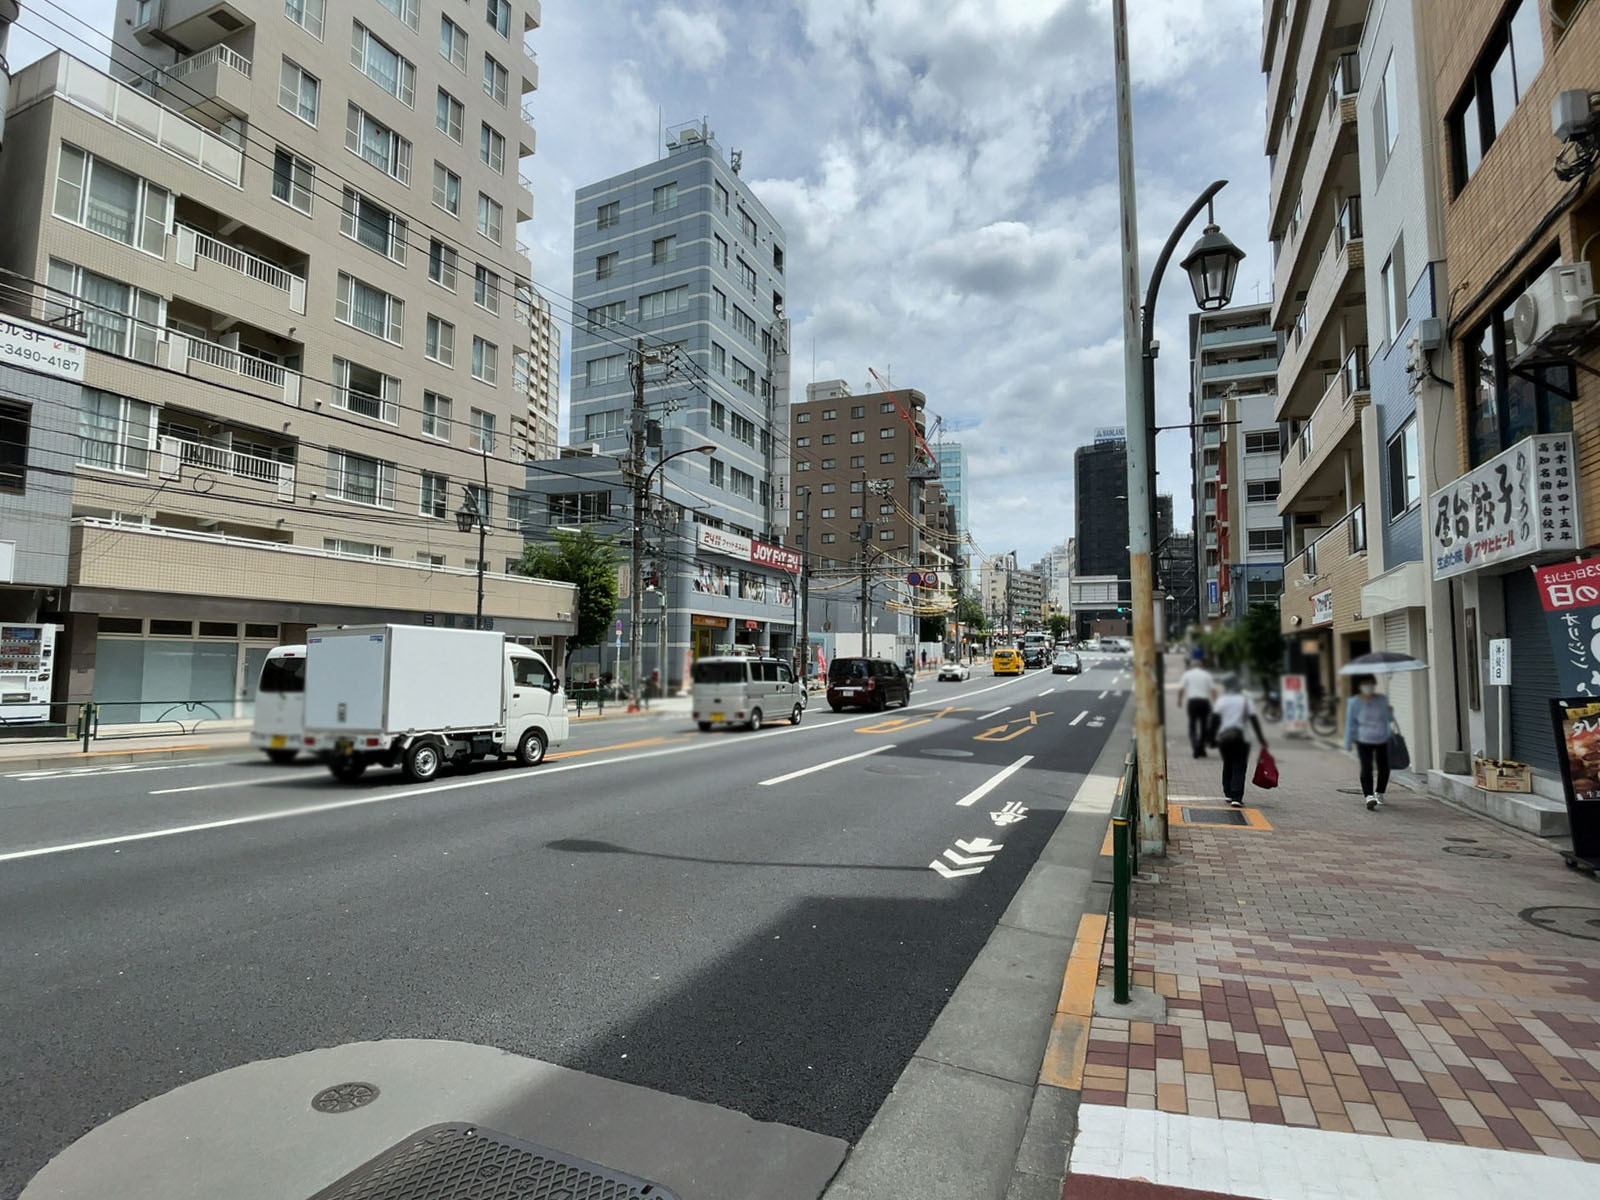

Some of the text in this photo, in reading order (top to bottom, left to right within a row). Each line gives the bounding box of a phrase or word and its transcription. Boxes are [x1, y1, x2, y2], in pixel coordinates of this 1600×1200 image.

[1474, 530, 1515, 558] アサヒビール
